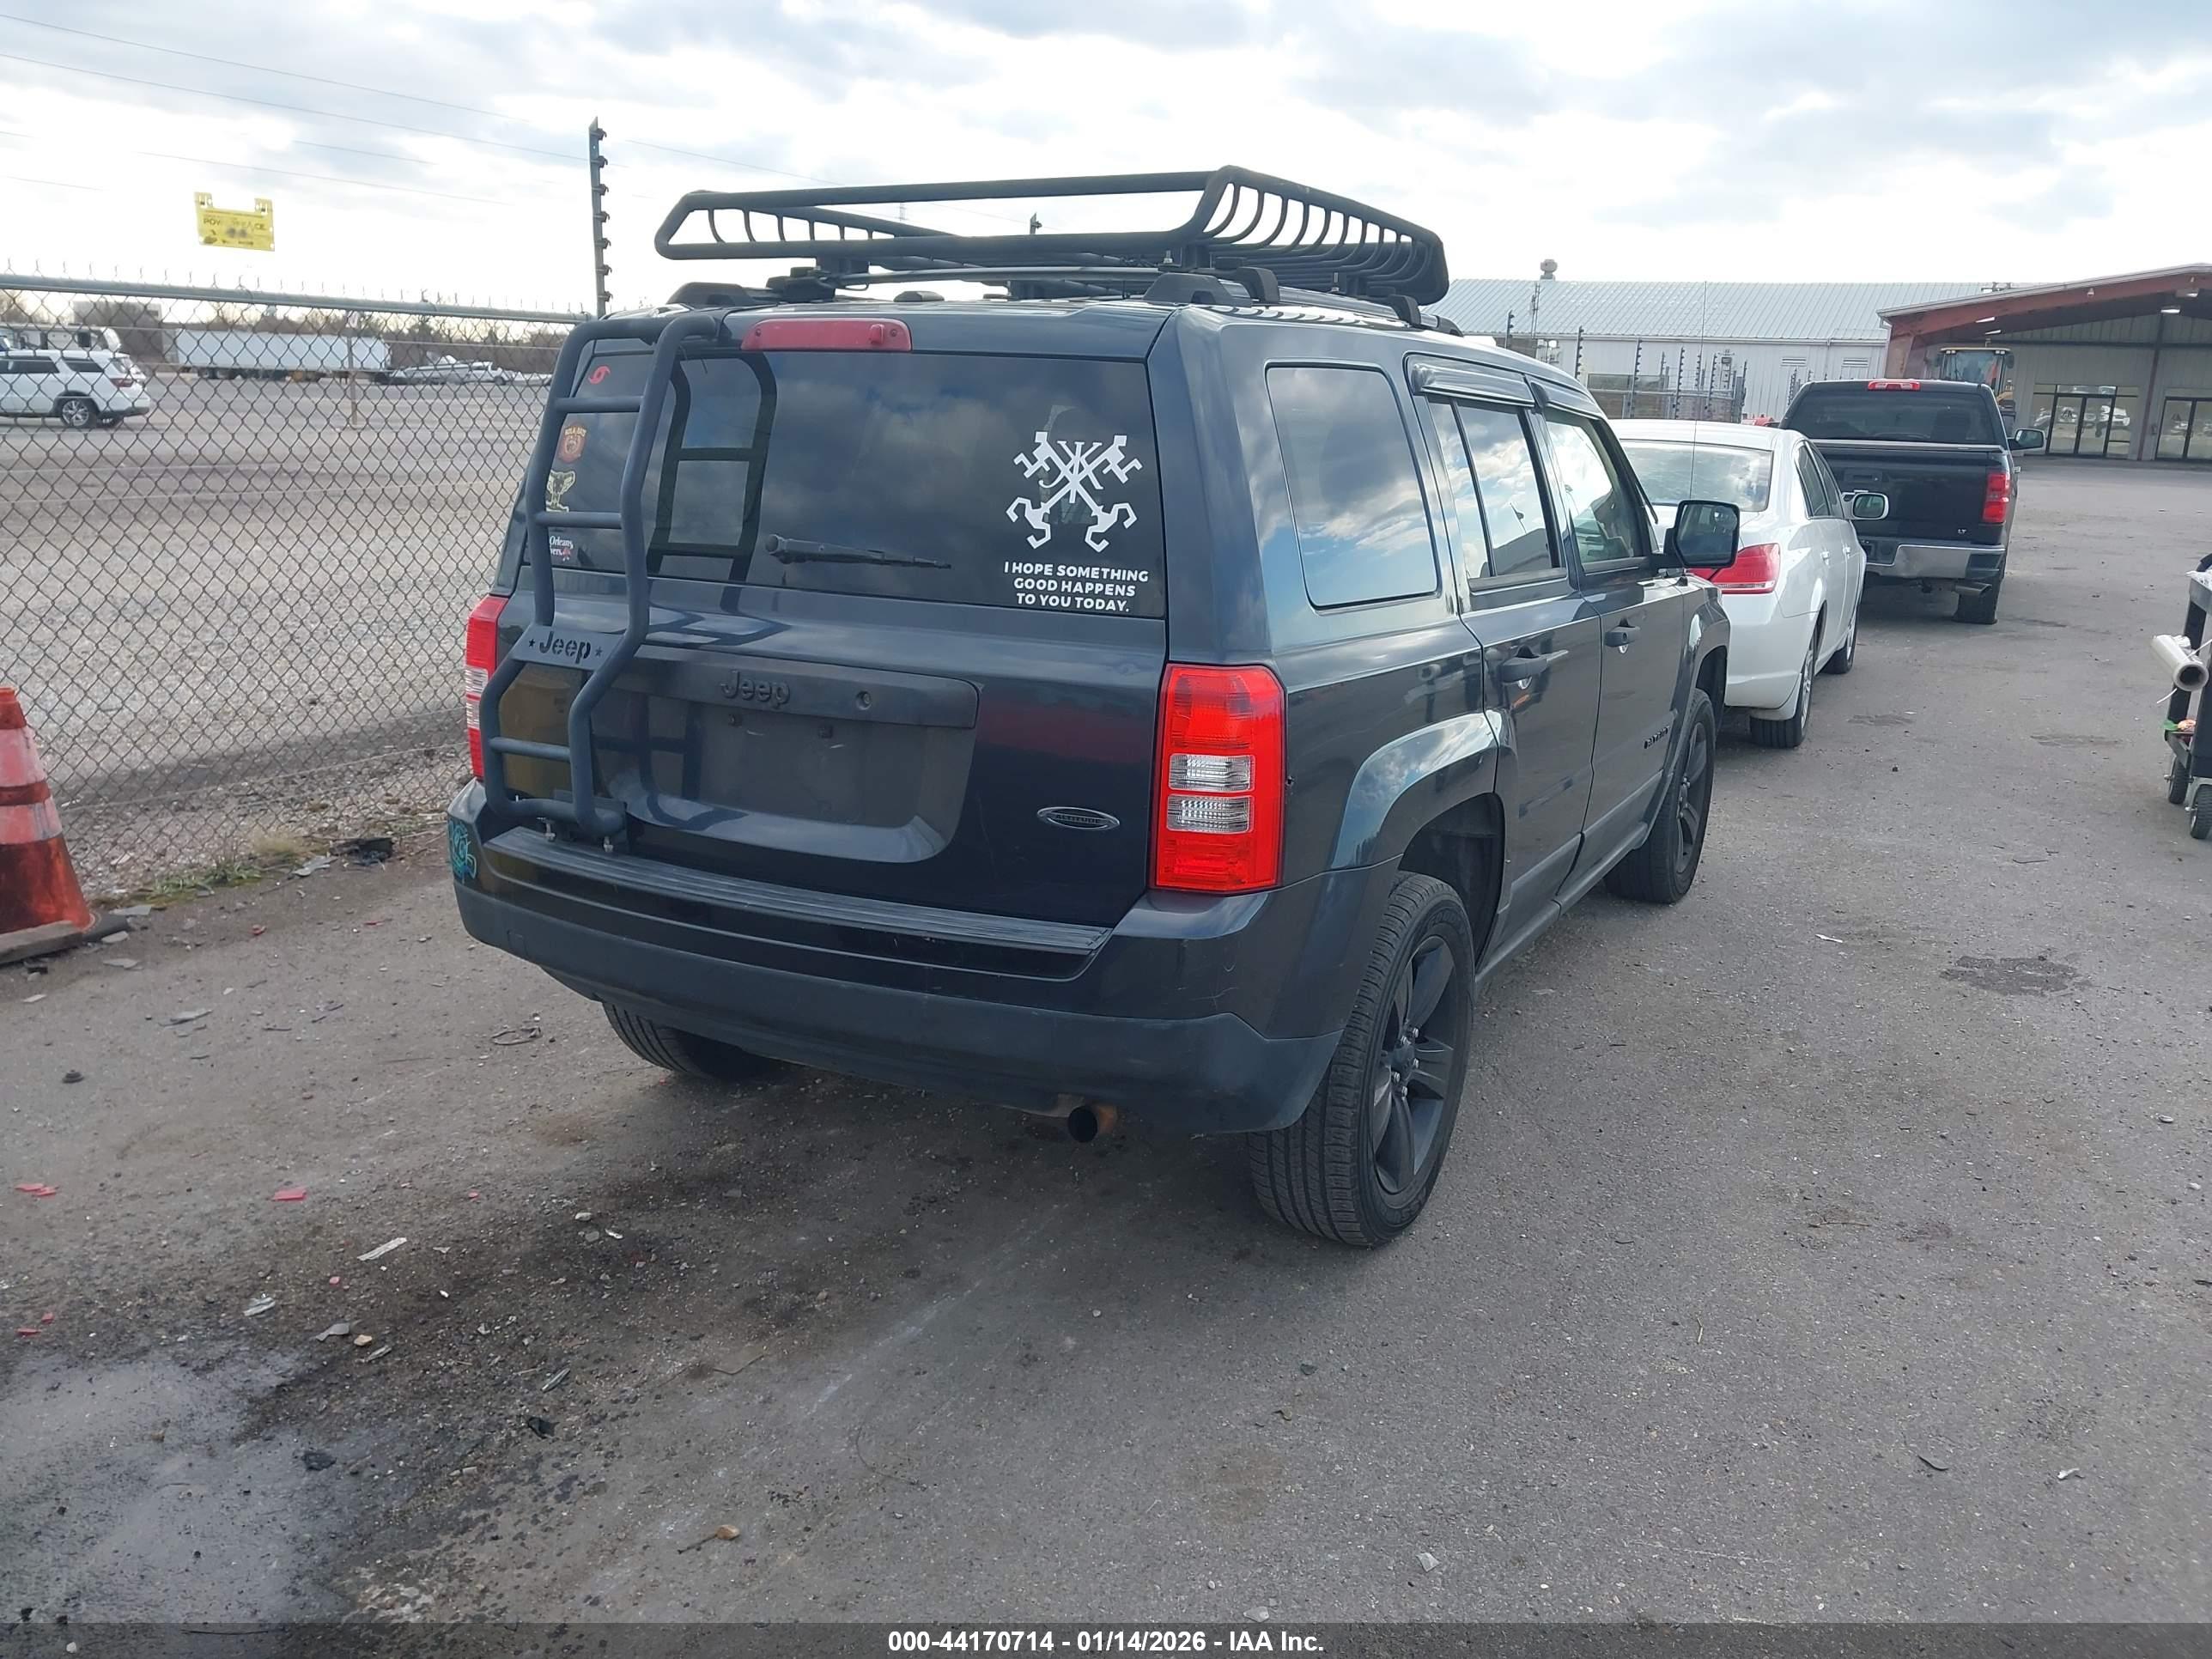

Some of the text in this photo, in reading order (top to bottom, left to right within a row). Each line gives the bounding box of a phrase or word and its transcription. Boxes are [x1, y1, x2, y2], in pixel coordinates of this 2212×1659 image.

[1004, 561, 1149, 582] I HOPE SOMETHING
[1013, 577, 1136, 597] GOOD HAPPENS
[1016, 592, 1130, 612] TO YOU TODAY.
[539, 630, 591, 665] Jeep
[720, 669, 790, 710] Jeep
